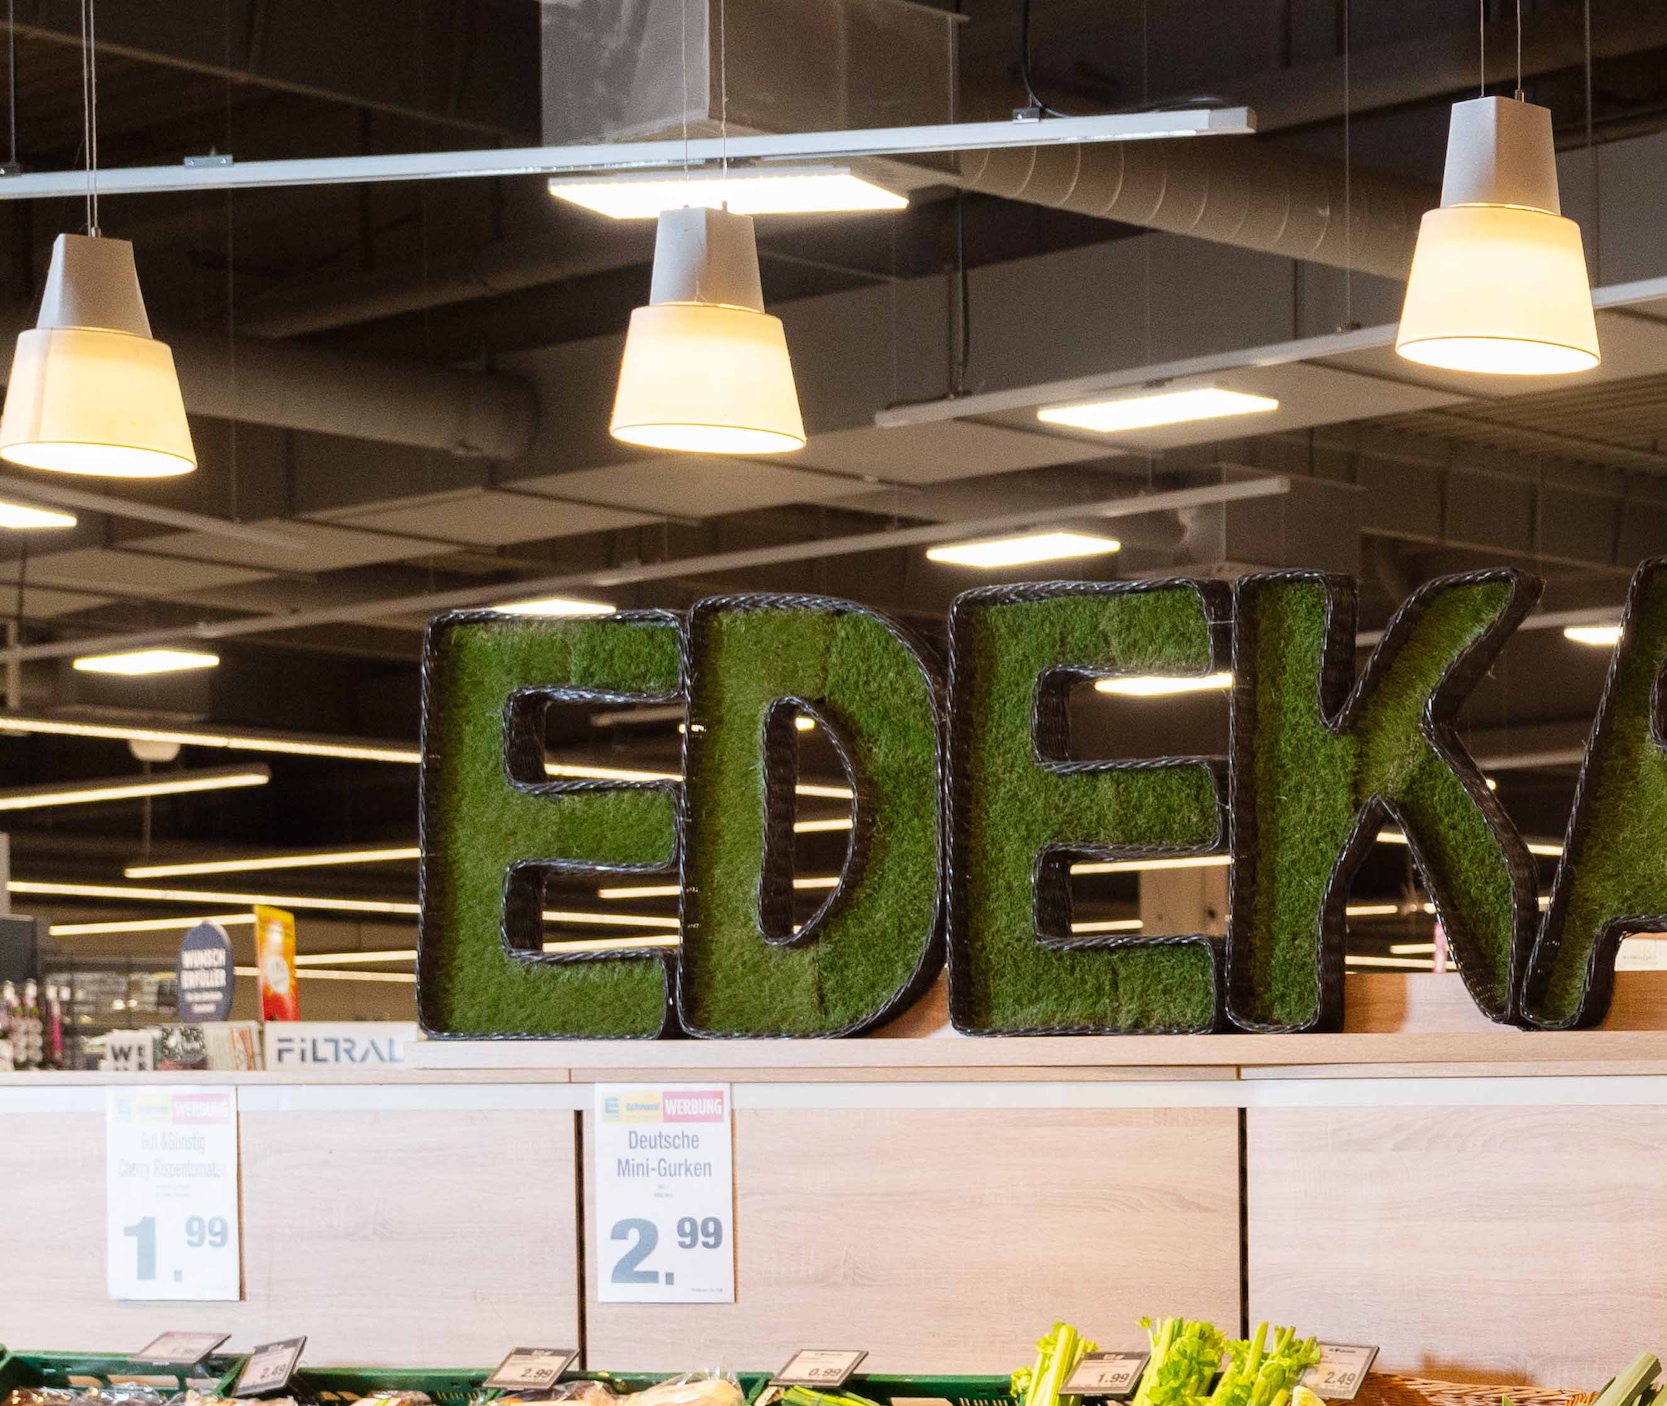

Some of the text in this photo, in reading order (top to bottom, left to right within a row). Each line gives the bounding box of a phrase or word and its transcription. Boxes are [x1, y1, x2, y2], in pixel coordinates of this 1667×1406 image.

[665, 1098, 722, 1115] WERBUNG
[628, 1131, 700, 1150] Deutsche
[617, 1158, 712, 1178] Mini-Gurken
[521, 1368, 553, 1379] 2.99
[808, 1367, 842, 1377] 0.99
[1097, 1373, 1130, 1383] 1.99
[1324, 1371, 1357, 1386] 2.49
